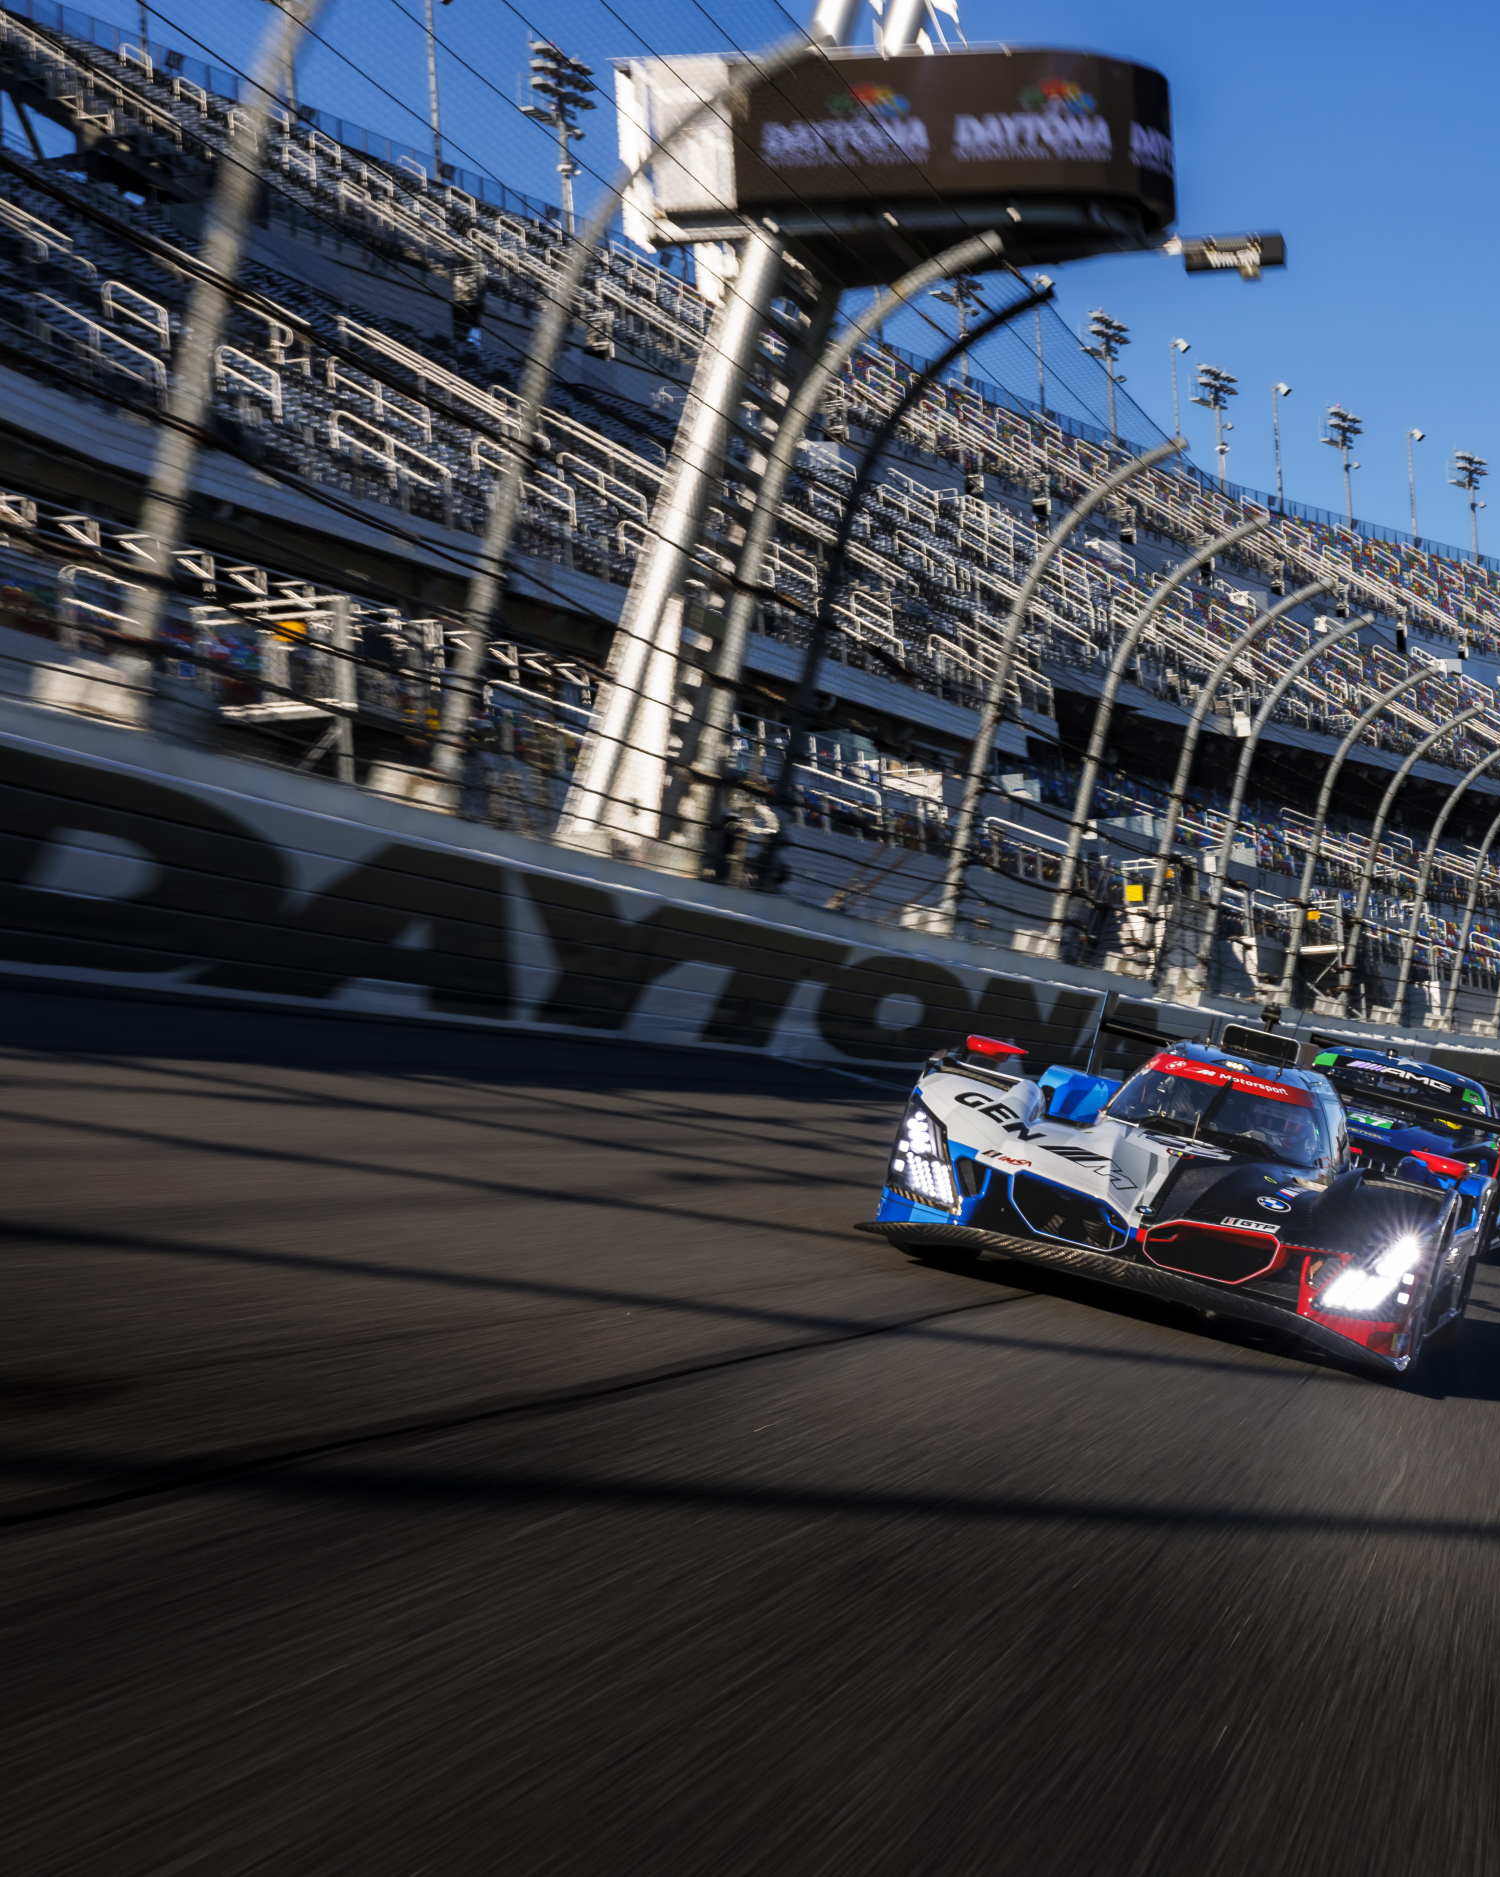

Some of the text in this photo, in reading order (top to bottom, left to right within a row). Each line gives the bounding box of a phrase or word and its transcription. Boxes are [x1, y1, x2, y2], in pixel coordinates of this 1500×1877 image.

[1219, 1073, 1289, 1096] Motorsport
[1380, 1066, 1453, 1094] AMG
[954, 1091, 1048, 1142] GEN
[1349, 1112, 1388, 1127] 57
[998, 1155, 1033, 1168] IMSA
[1240, 1220, 1277, 1231] GTP
